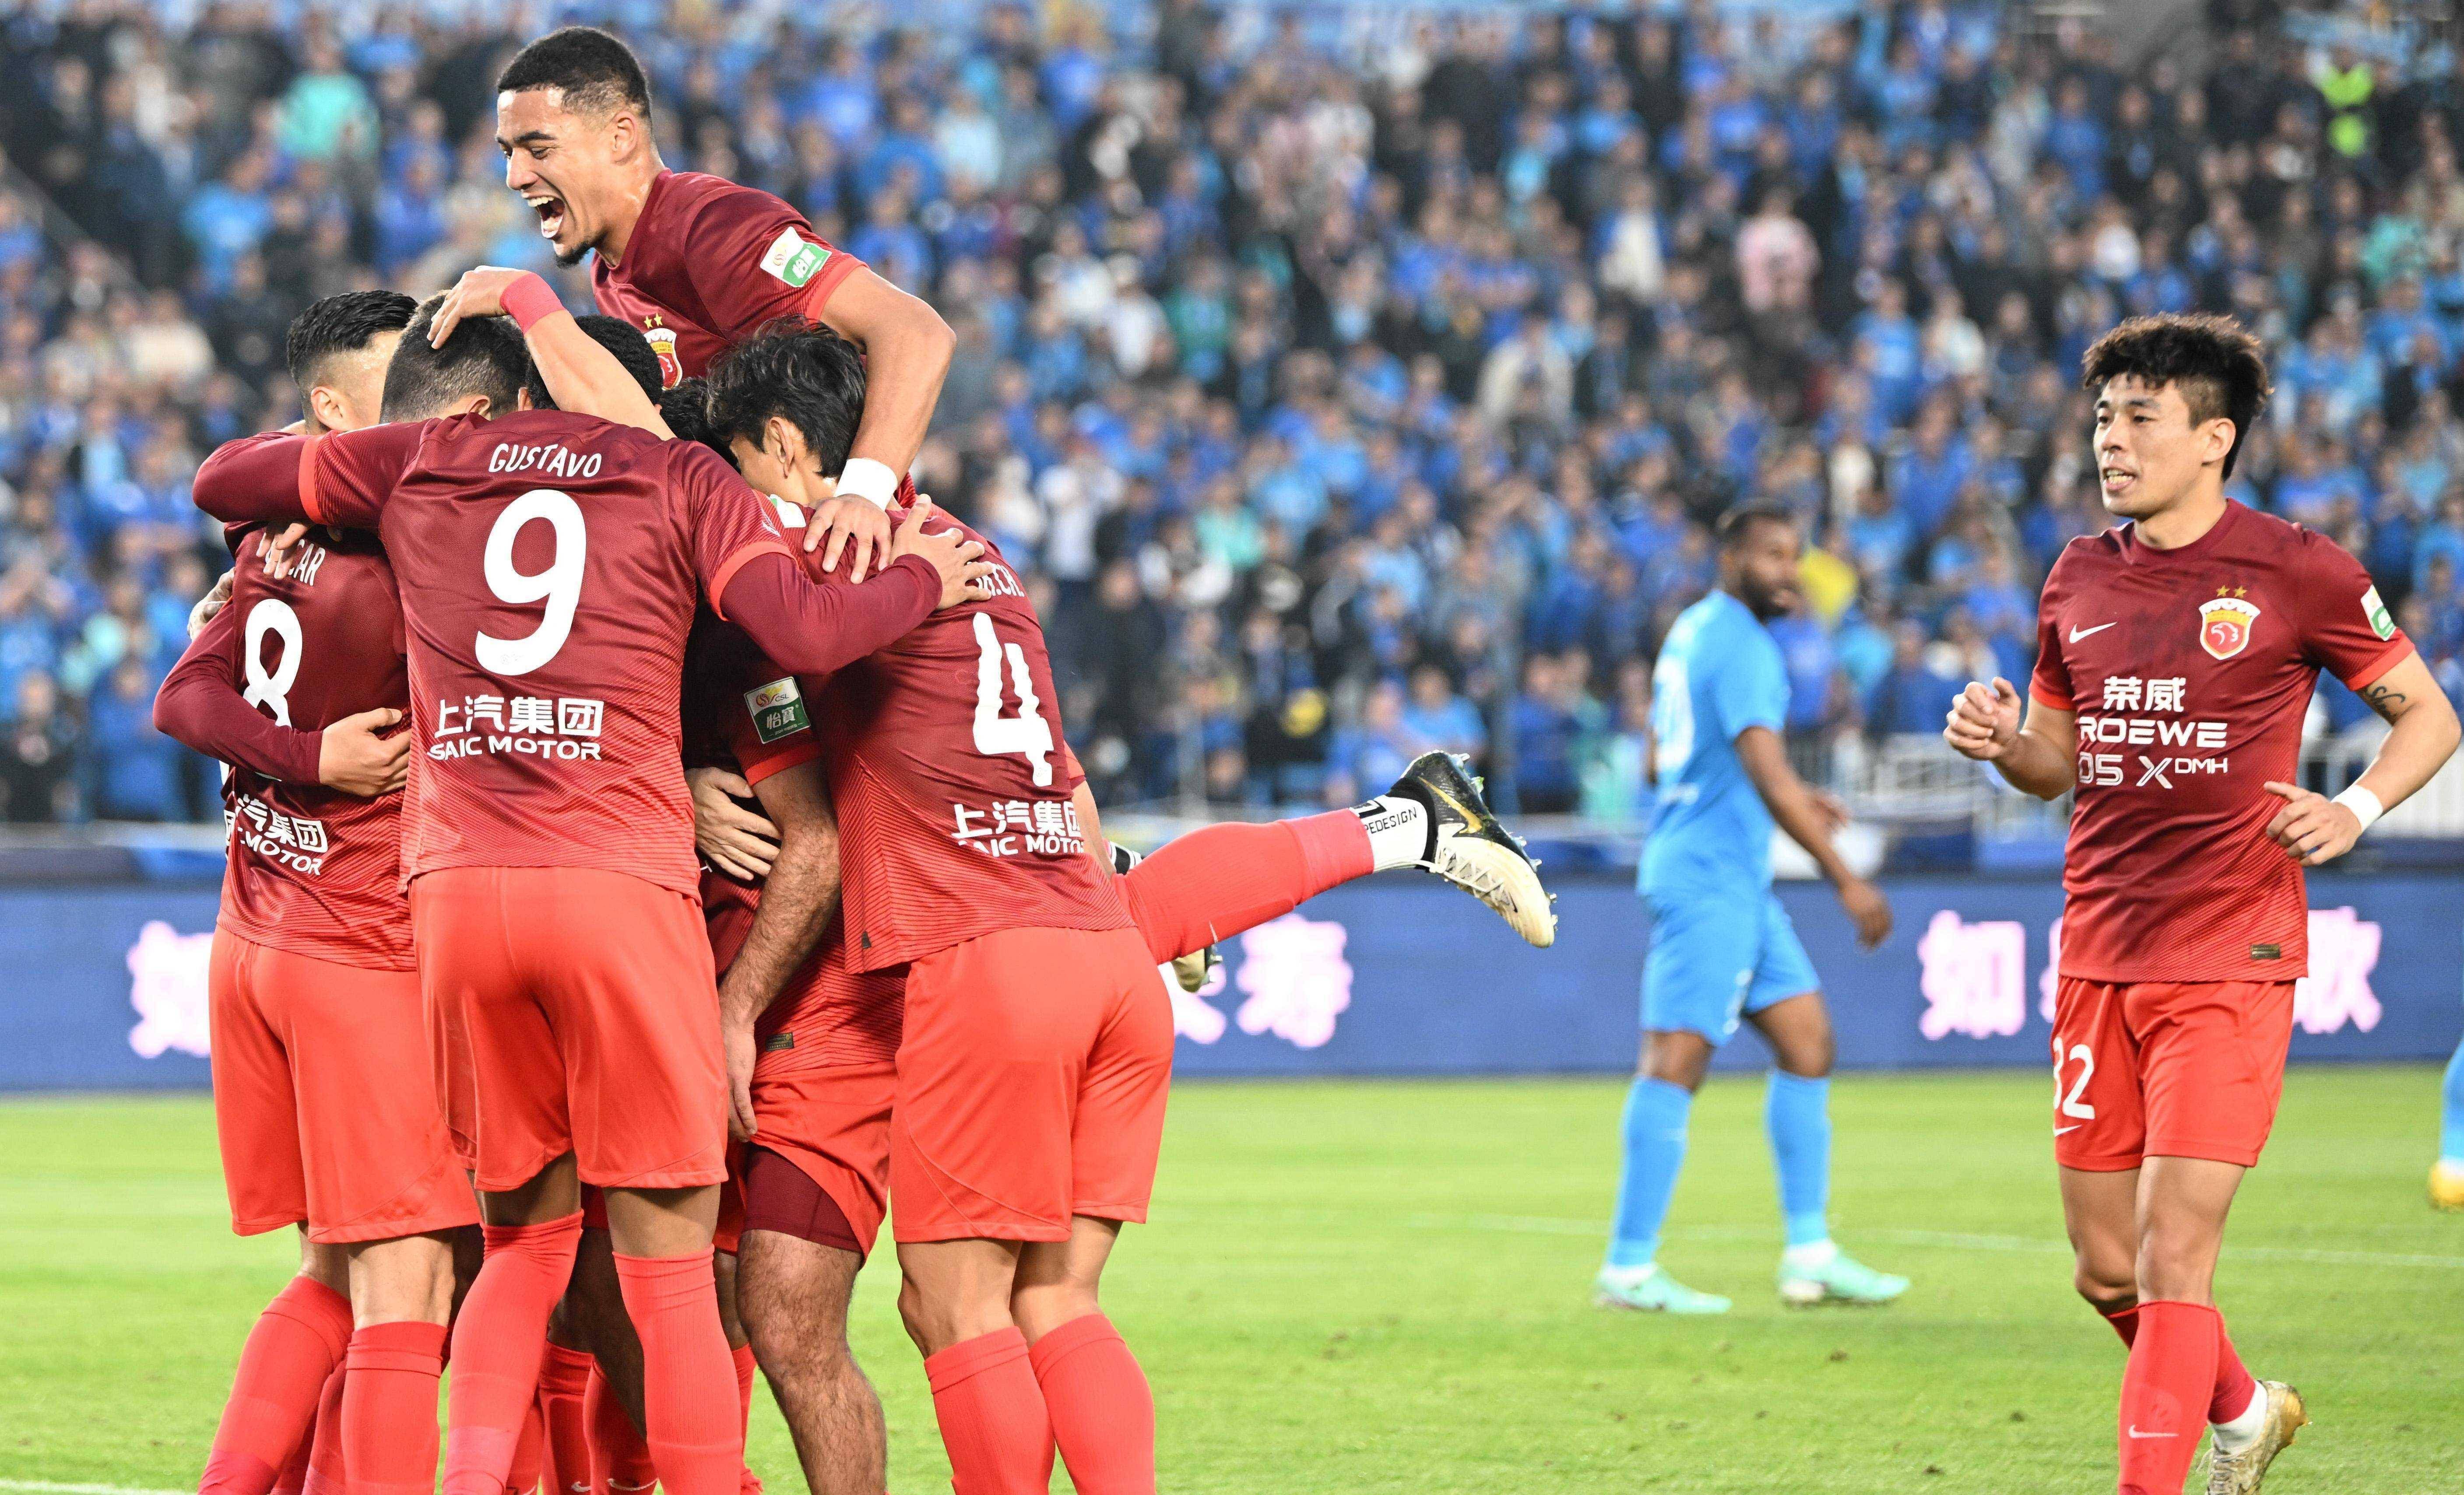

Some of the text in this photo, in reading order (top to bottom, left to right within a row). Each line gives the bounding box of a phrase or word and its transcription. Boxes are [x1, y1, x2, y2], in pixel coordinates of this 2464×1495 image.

[489, 443, 602, 477] GUSTAVO
[475, 489, 587, 676] 9
[243, 598, 302, 731] 8
[775, 693, 790, 702] CSL
[973, 612, 1054, 787] 4
[2102, 675, 2186, 712] 荣威
[434, 694, 604, 739] 上汽集团
[2079, 716, 2228, 748] ROEWE
[427, 735, 602, 760] SAIC MOTOR
[2175, 757, 2228, 774] DMH
[235, 793, 328, 853] 汽集团
